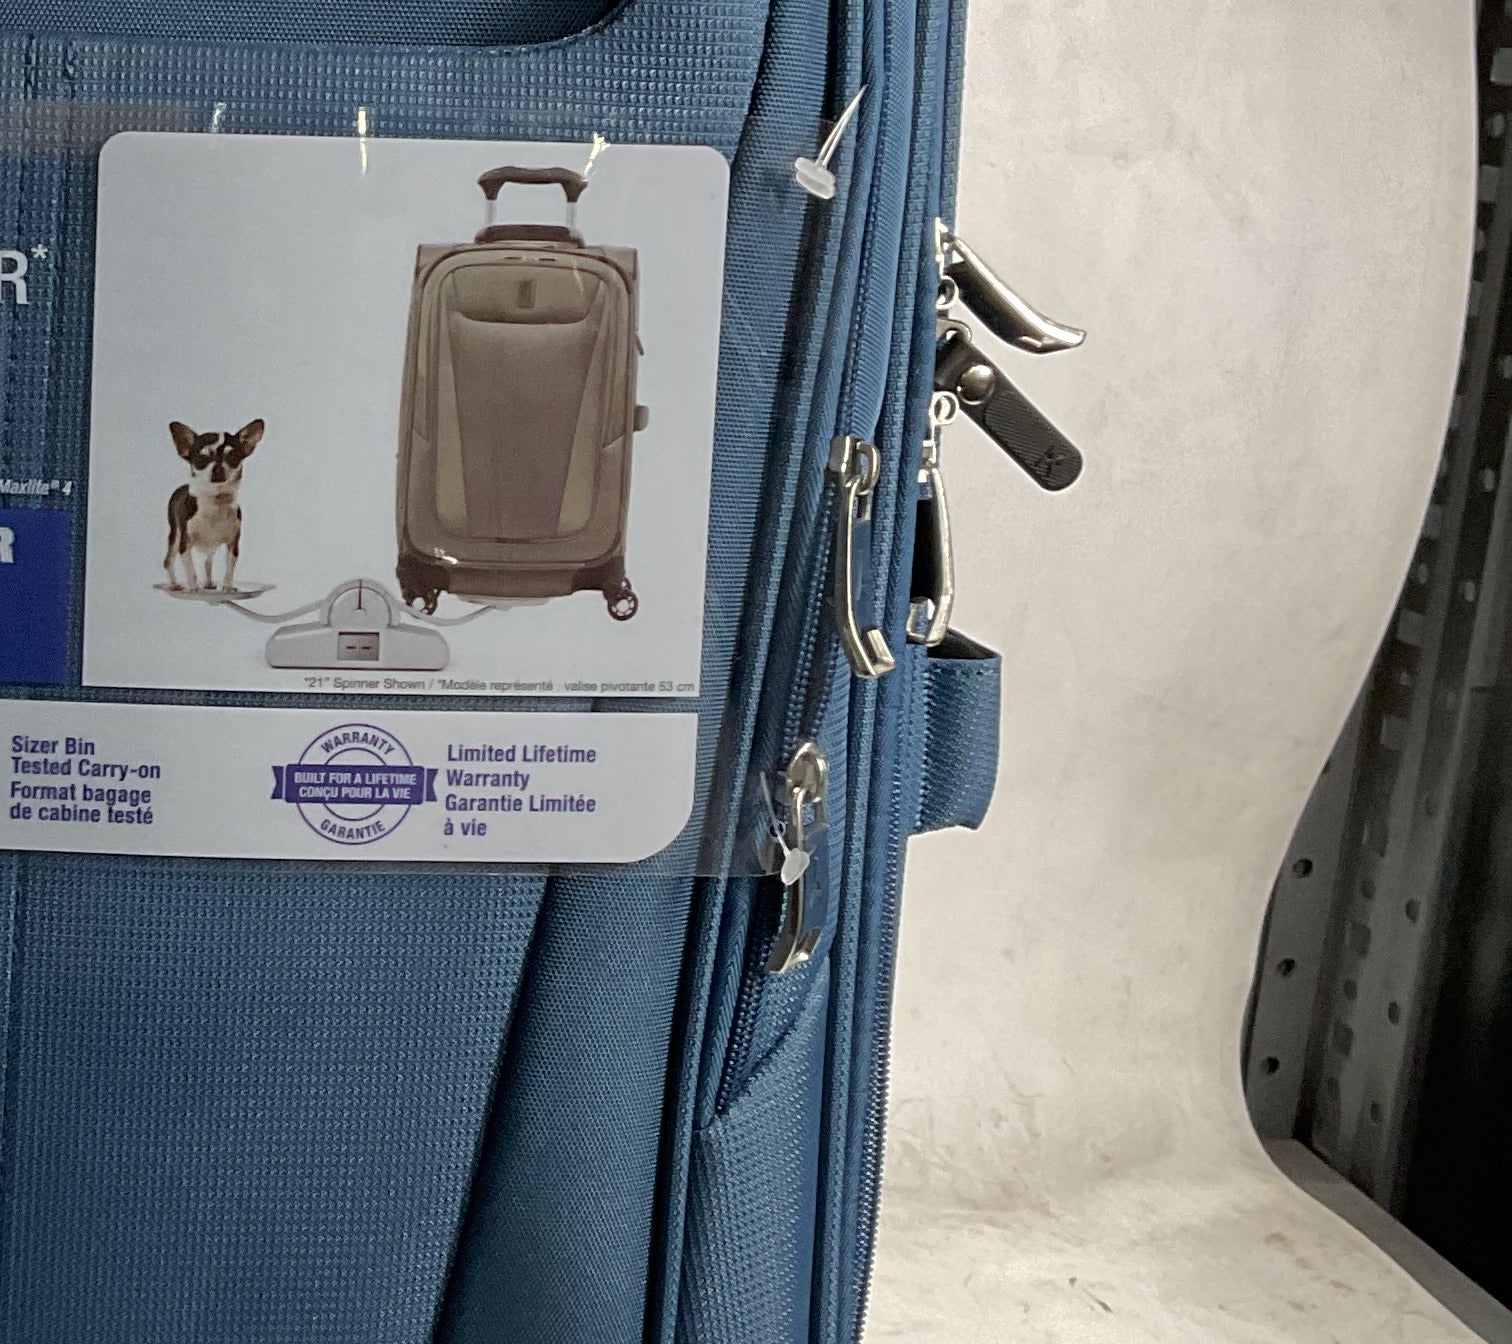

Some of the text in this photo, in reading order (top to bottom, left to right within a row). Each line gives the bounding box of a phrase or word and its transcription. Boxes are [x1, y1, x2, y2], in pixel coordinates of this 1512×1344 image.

[62, 479, 73, 497] 4
[333, 677, 380, 690] Spinner
[383, 678, 426, 690] Shown
[564, 680, 598, 693] valise
[600, 681, 656, 694] pivotante
[658, 681, 674, 693] 53
[676, 682, 695, 693] cm
[11, 734, 95, 757] Sizer Bin
[320, 731, 397, 755] WARRANTY
[447, 744, 597, 764] Limited Lifetime
[11, 756, 161, 782] Tested Carry-on
[294, 771, 417, 786] BUILT FOR A LIFETIME
[446, 769, 530, 792] Warranty
[10, 780, 152, 808] Format bagage
[341, 787, 373, 799] POUR
[375, 787, 389, 799] LA
[392, 787, 412, 800] VIE
[445, 793, 596, 813] Garantie Limitée
[9, 802, 154, 825] de cabine testé
[320, 818, 386, 840] GARANTIE
[443, 817, 487, 837] à vie
